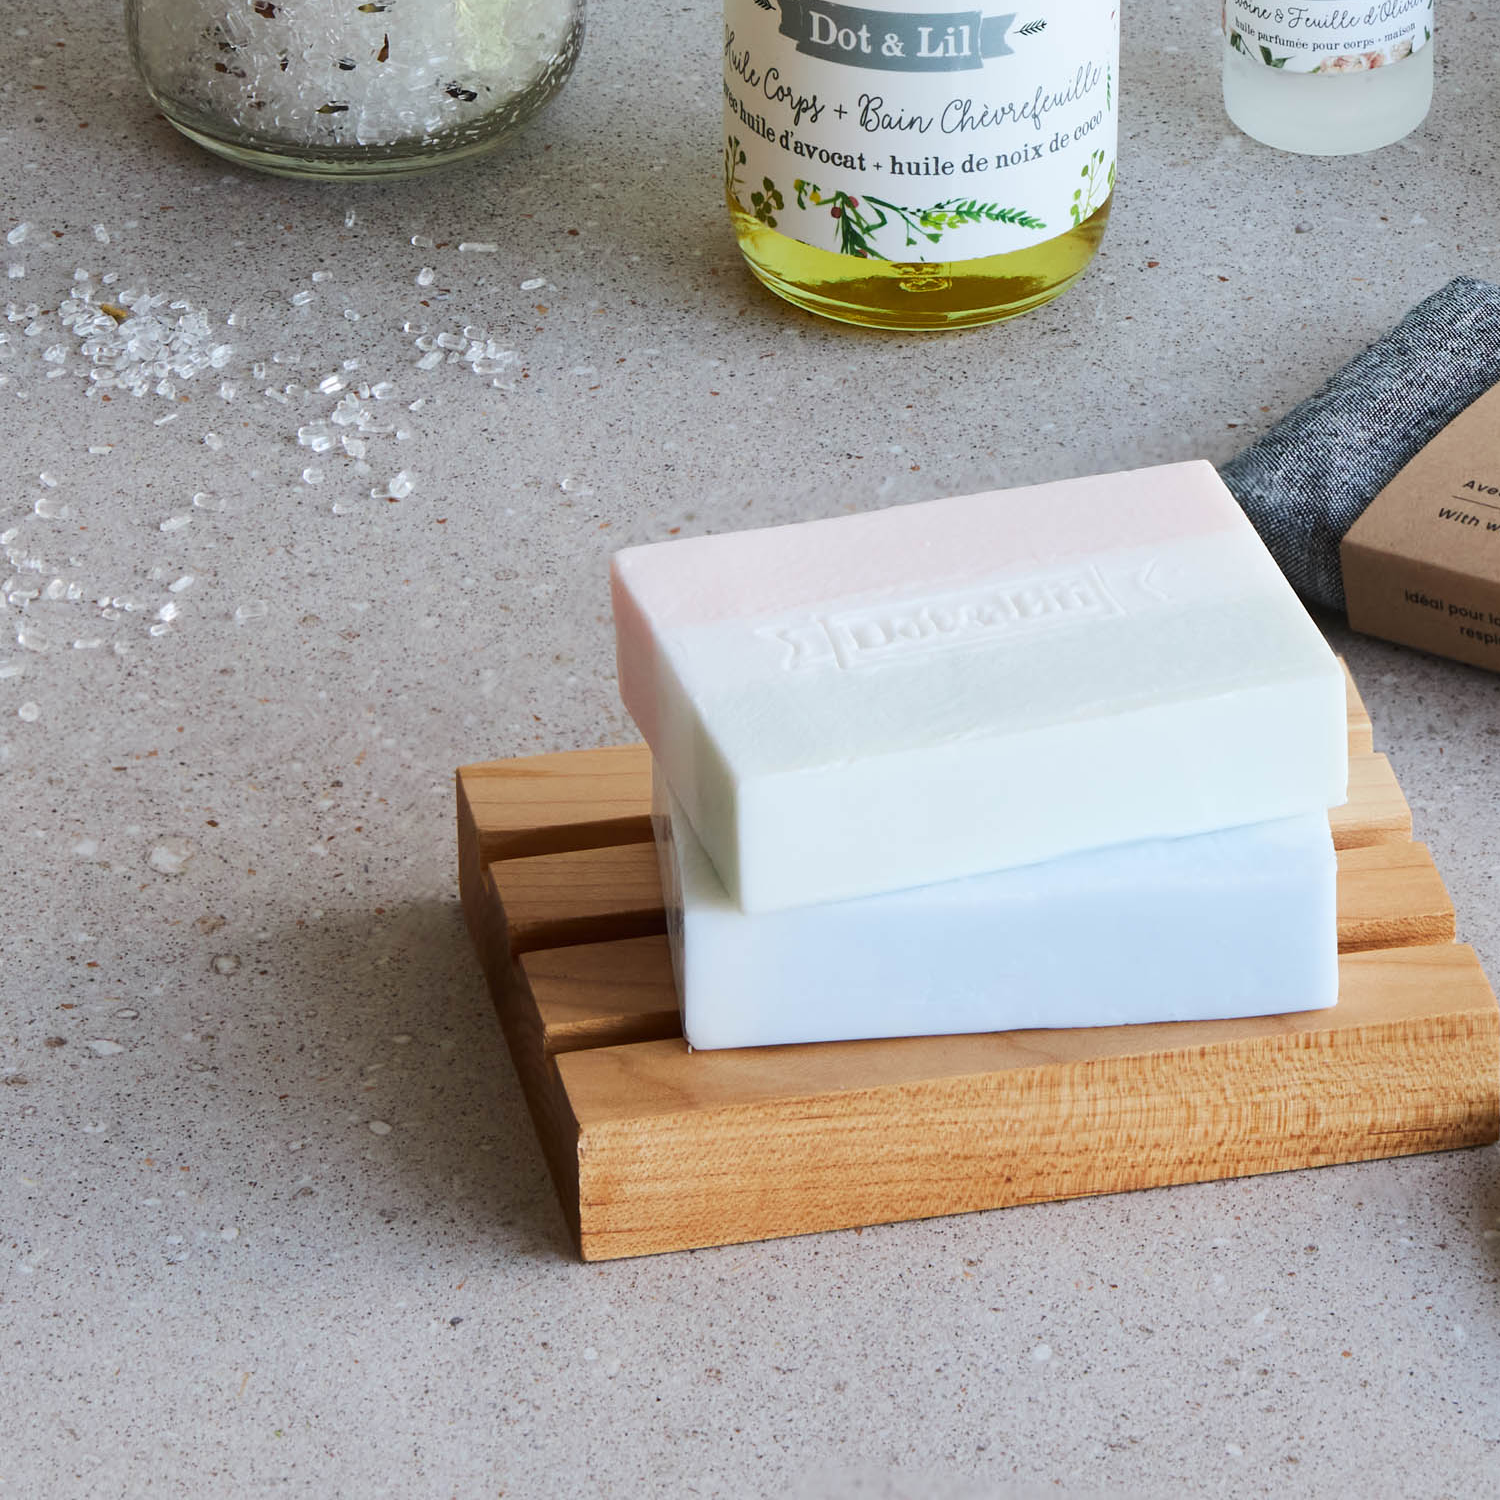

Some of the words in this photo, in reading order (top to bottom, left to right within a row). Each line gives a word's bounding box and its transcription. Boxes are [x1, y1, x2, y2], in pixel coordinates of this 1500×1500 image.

[809, 10, 872, 54] Dot
[881, 32, 906, 57] &
[916, 25, 972, 58] Lil
[1235, 16, 1256, 37] huile
[1257, 30, 1309, 50] parfumée
[1312, 41, 1340, 52] pour
[1343, 38, 1375, 50] corps
[1384, 21, 1416, 42] maison
[1274, 8, 1284, 23] &
[1288, 6, 1360, 29] Feuille
[763, 67, 825, 126] Corps
[833, 104, 848, 119] +
[858, 93, 933, 134] Bain
[739, 99, 776, 143] huile
[779, 129, 866, 171] d'avocat
[873, 162, 882, 170] +
[889, 155, 954, 176] huile
[961, 153, 988, 172] de
[995, 142, 1044, 169] noix
[1049, 132, 1070, 153] de
[1073, 110, 1103, 141] coco
[1438, 508, 1480, 527] With
[1404, 589, 1444, 612] Idéal
[1448, 603, 1484, 623] pour
